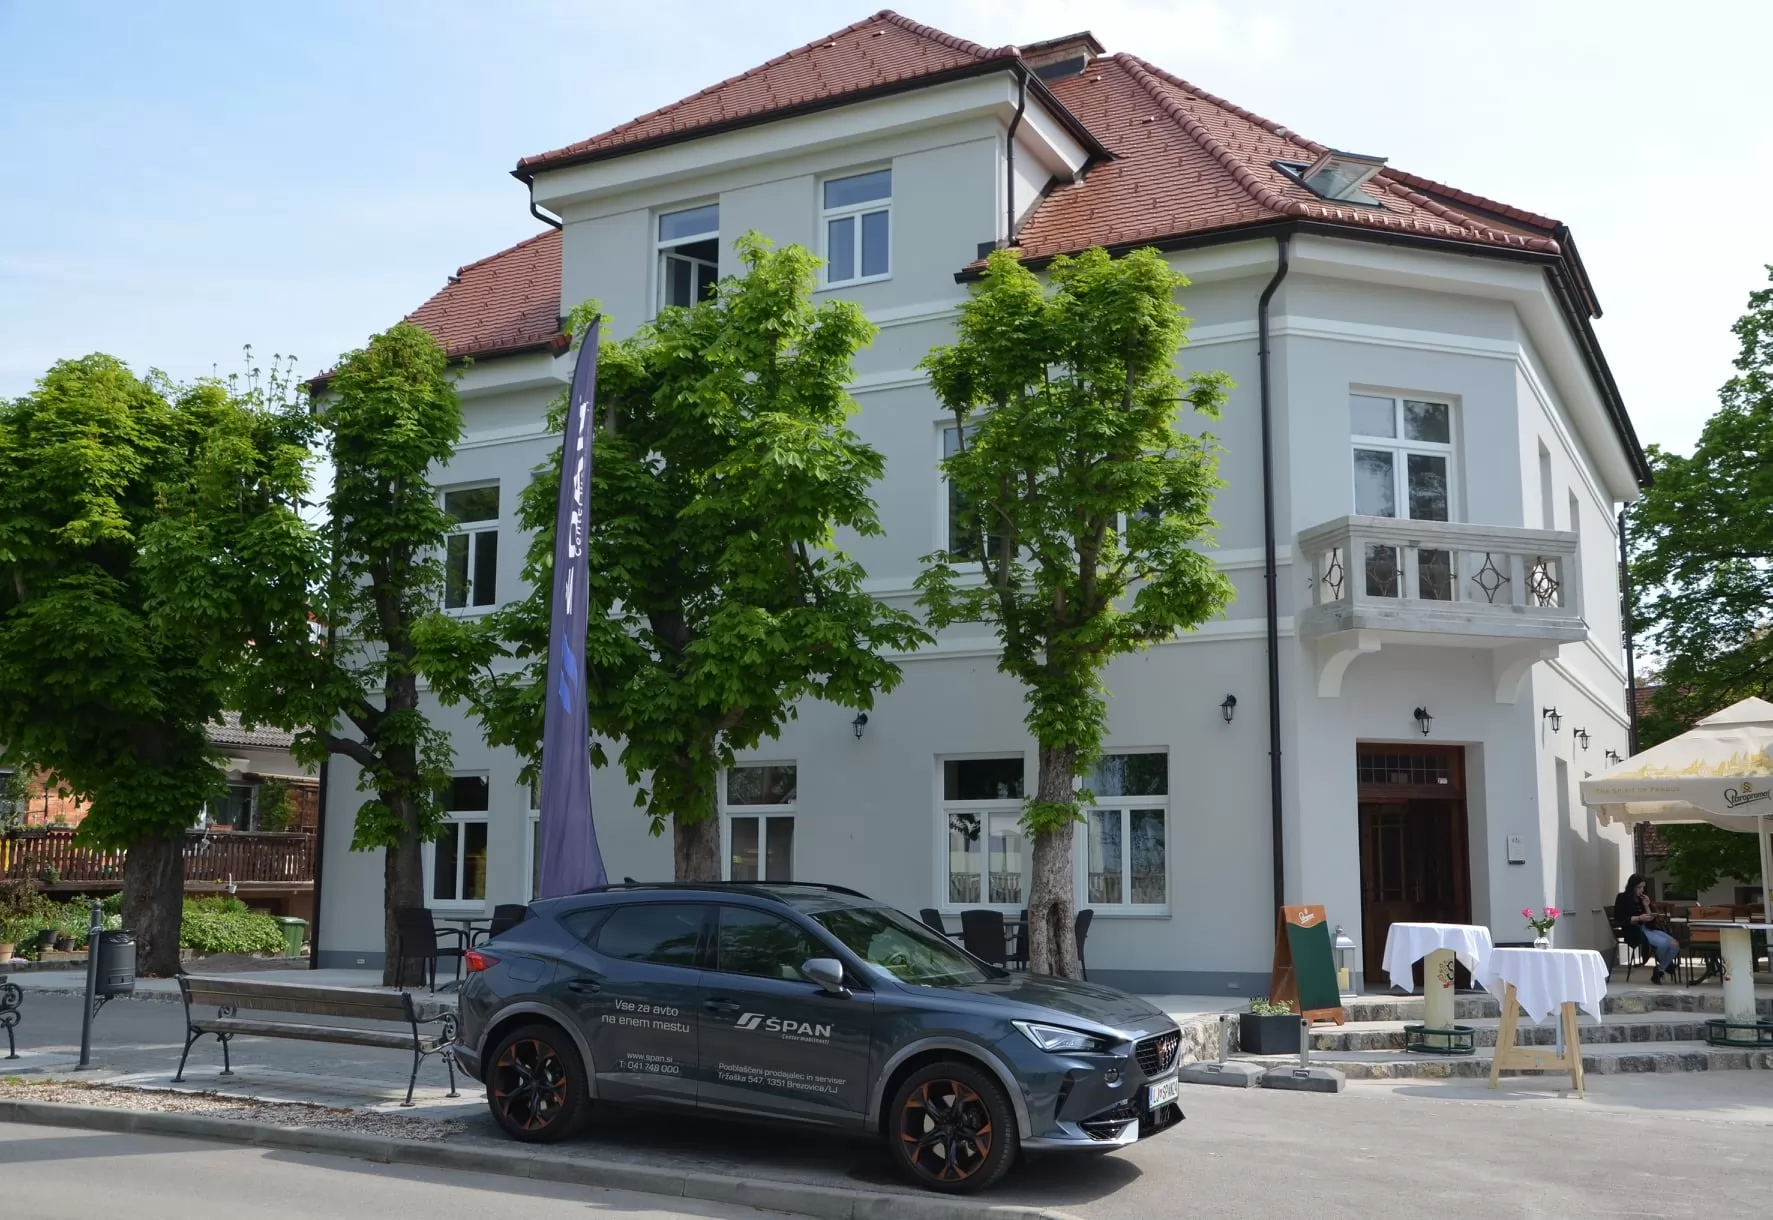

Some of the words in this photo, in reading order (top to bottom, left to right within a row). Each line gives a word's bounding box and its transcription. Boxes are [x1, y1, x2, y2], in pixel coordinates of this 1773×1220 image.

[615, 999, 635, 1011] Vse
[637, 1003, 650, 1013] za
[652, 1005, 679, 1017] avto
[601, 1014, 616, 1024] na
[618, 1016, 650, 1028] enem
[652, 1020, 690, 1033] mestu
[765, 1016, 831, 1038] ŠPAN
[627, 1061, 643, 1069] 041
[767, 1078, 786, 1087] 1351
[806, 1073, 814, 1081] in
